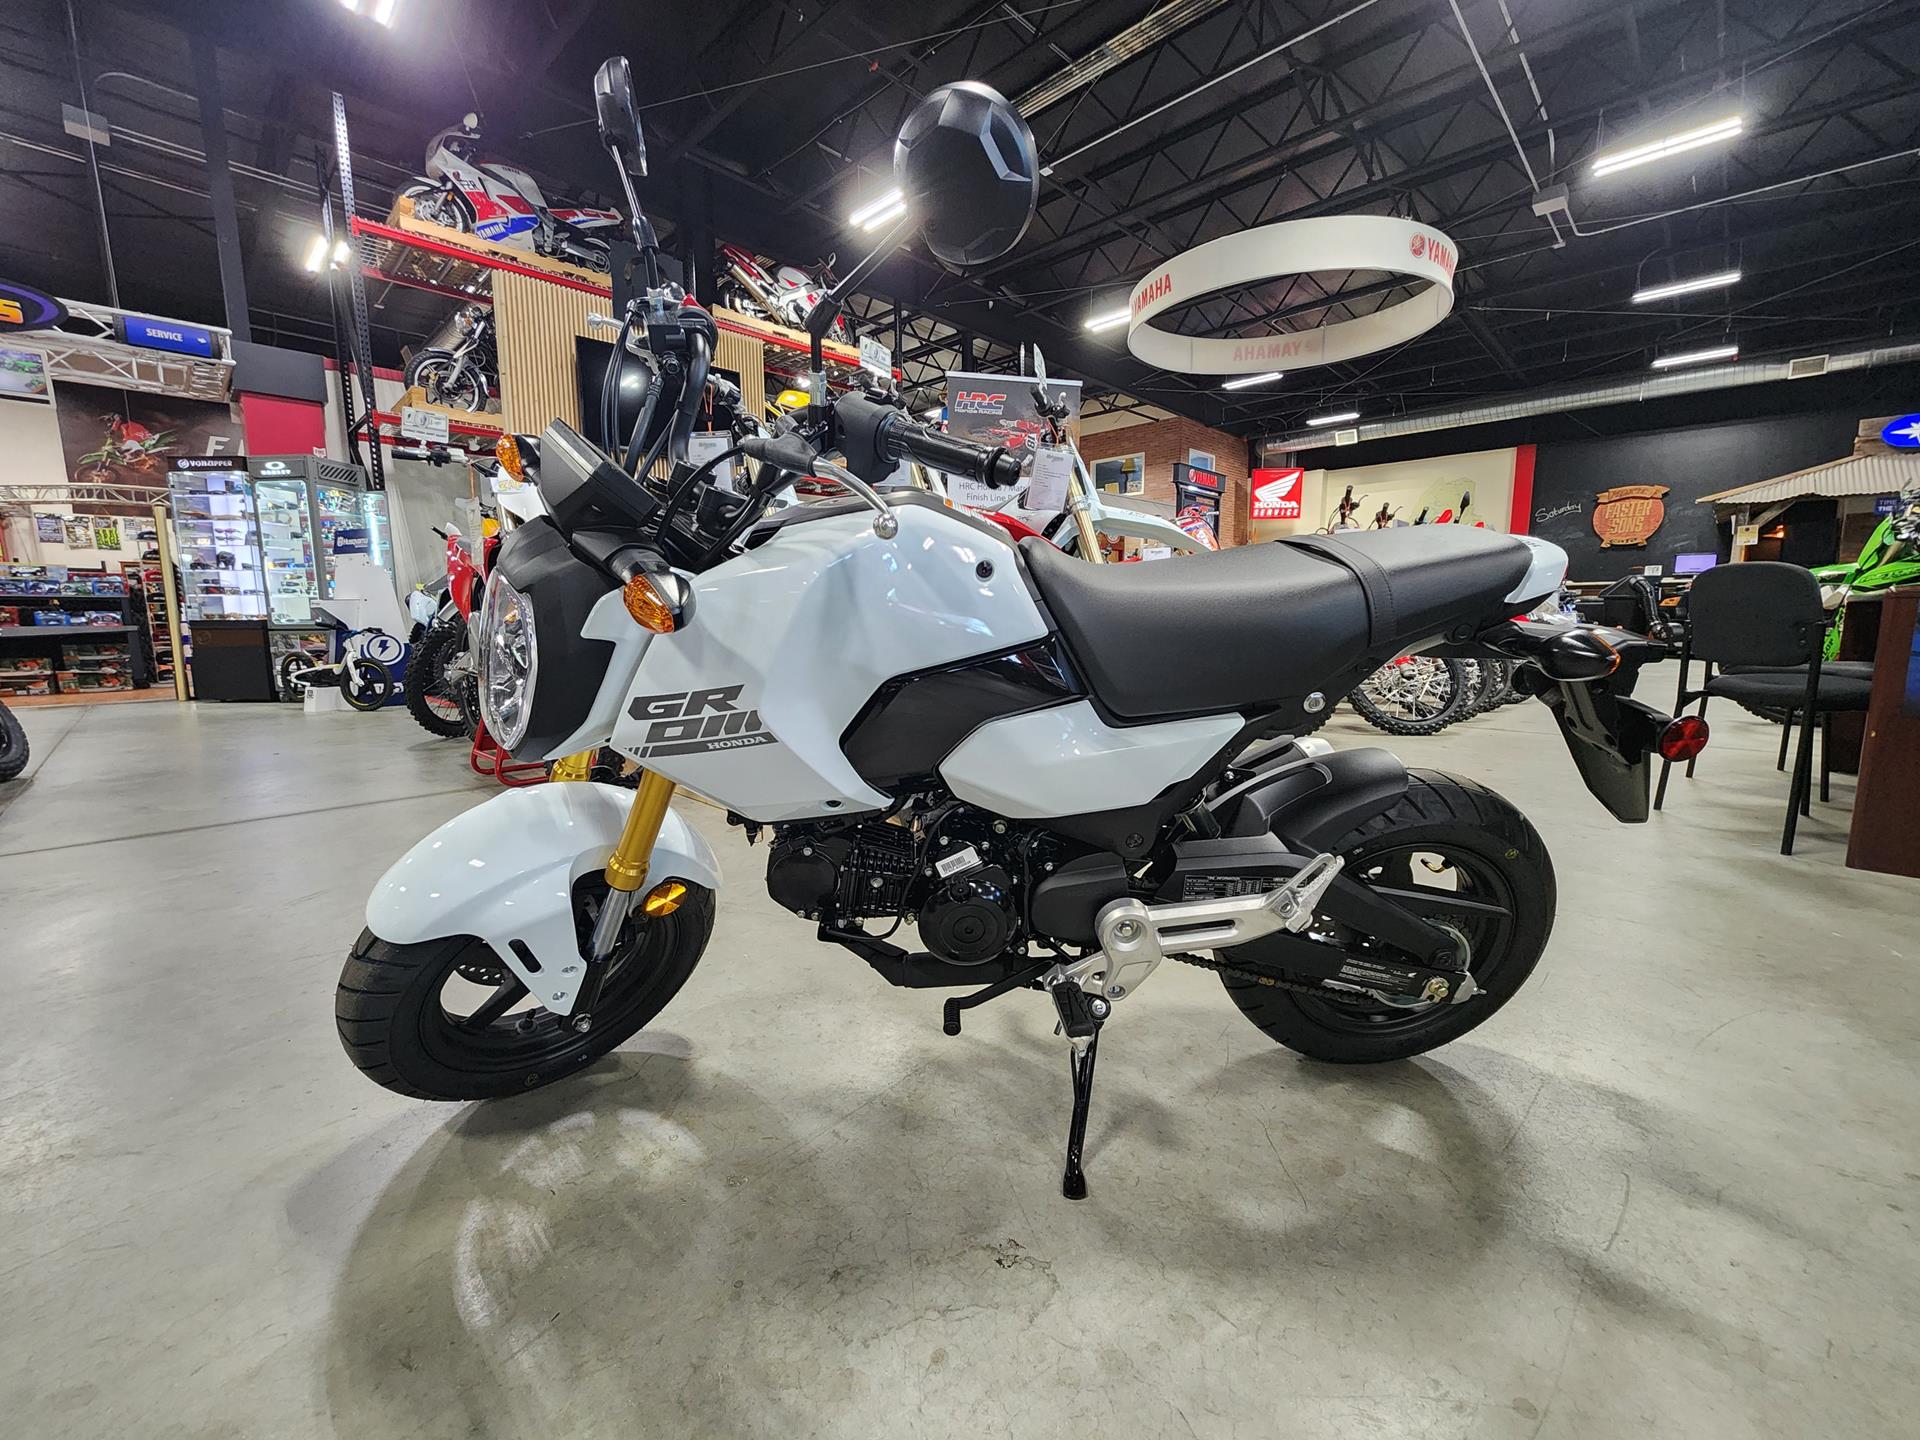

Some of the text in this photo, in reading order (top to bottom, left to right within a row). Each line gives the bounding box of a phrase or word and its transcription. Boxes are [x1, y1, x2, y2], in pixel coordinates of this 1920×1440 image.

[1133, 273, 1172, 318] YAMAHA
[146, 327, 184, 343] SERVICE
[955, 391, 1007, 410] HRC
[959, 482, 976, 491] HRC
[966, 493, 989, 501] Finish
[990, 494, 1006, 502] Line
[1254, 501, 1299, 509] HONDA
[1253, 508, 1299, 517] SERVICE
[1535, 501, 1582, 523] Saturday
[1605, 499, 1653, 519] FASTER
[1608, 515, 1645, 534] SONS
[706, 735, 768, 750] HONDA
